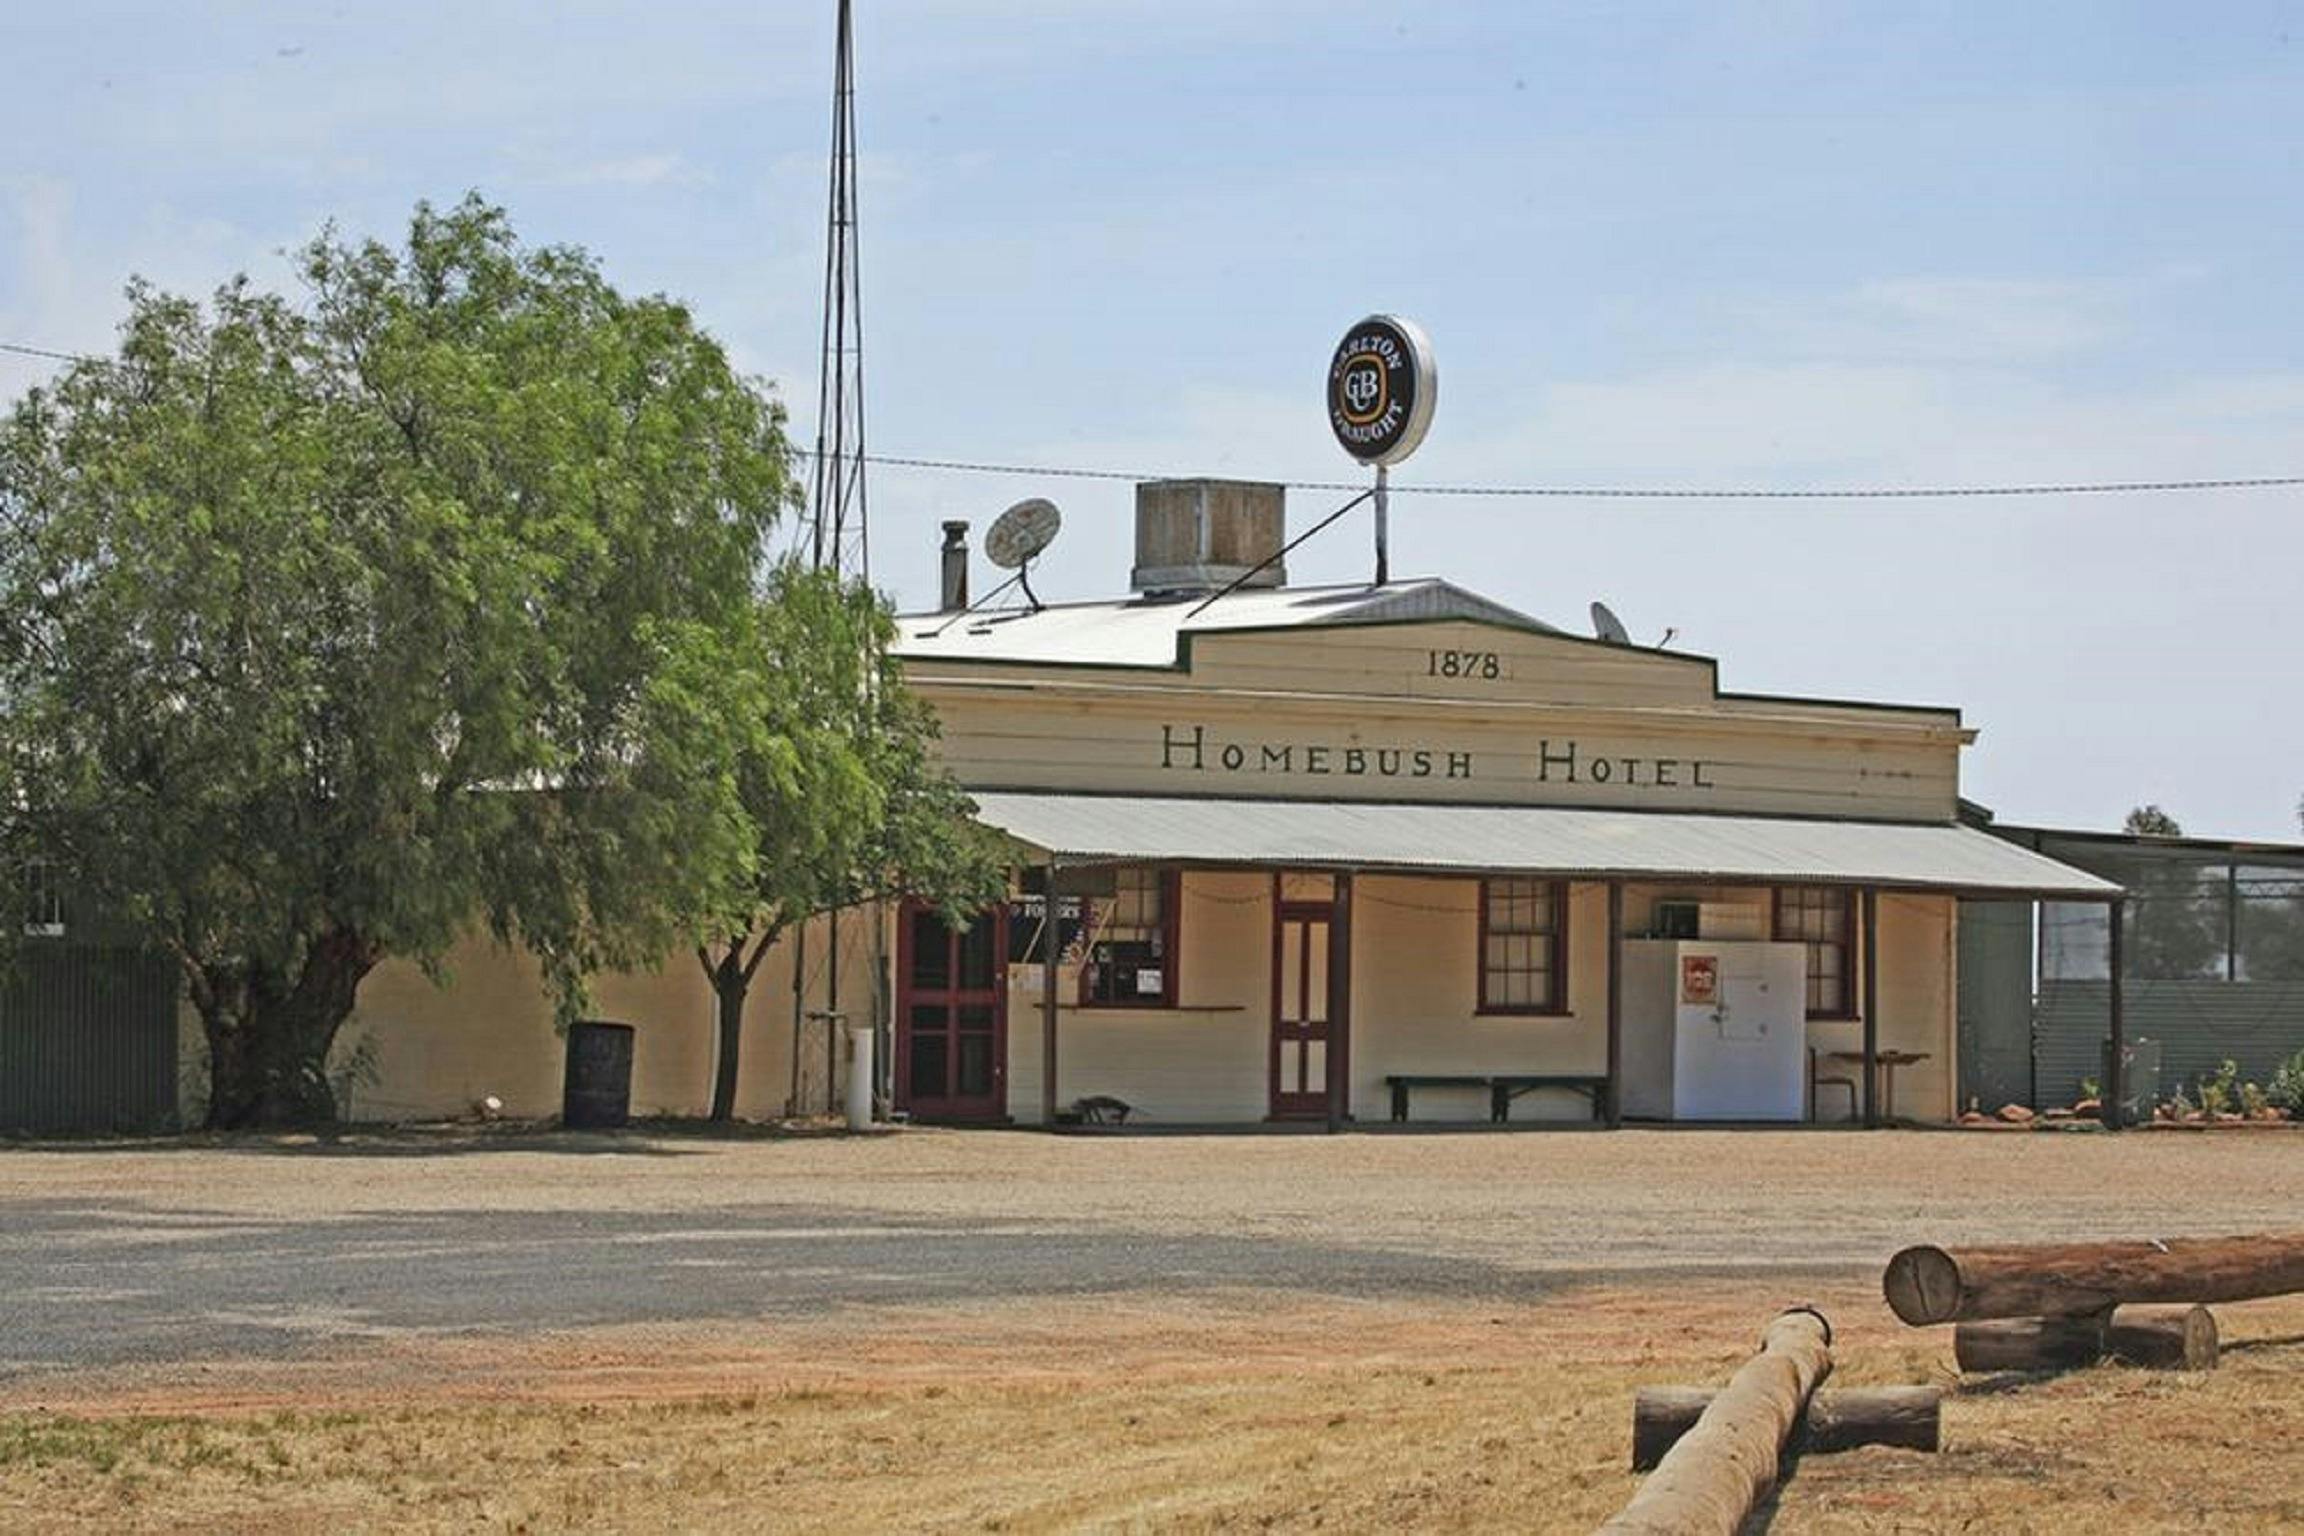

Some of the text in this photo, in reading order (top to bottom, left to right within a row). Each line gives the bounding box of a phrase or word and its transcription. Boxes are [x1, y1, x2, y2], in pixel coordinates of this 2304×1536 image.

[1428, 650, 1500, 680] 1878
[1161, 725, 1715, 788] HOMEBUSH HOTEL
